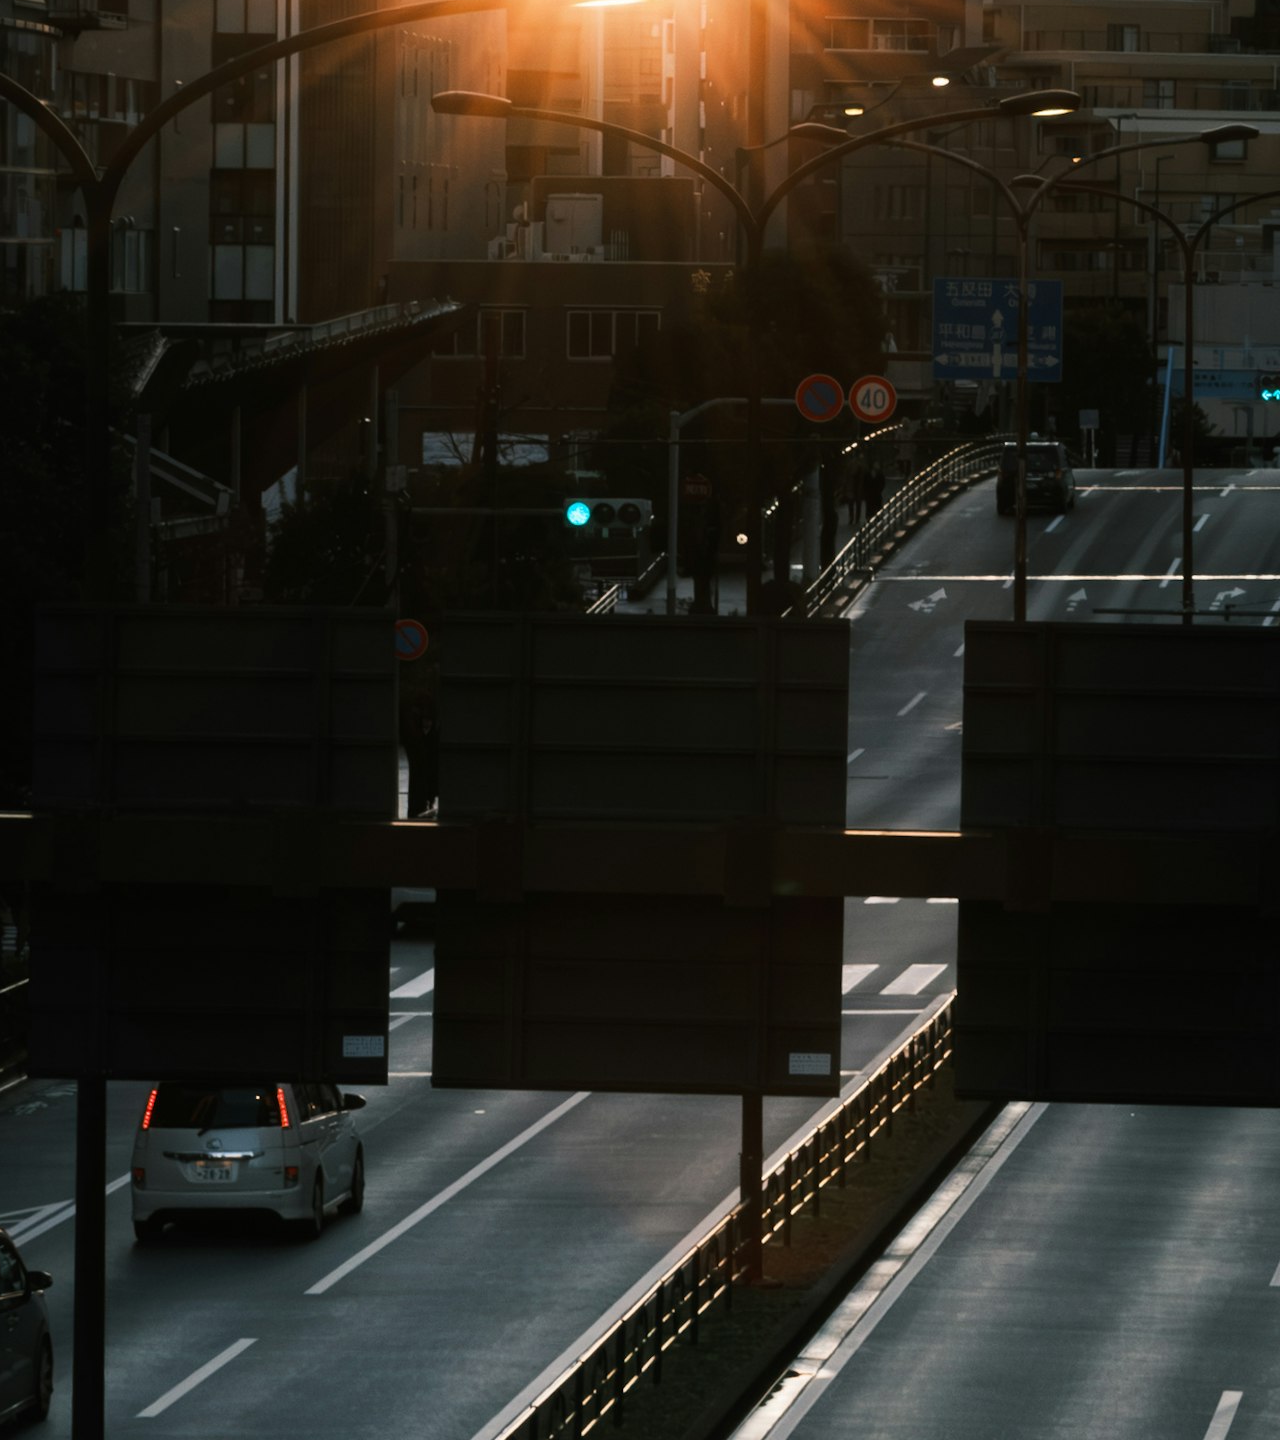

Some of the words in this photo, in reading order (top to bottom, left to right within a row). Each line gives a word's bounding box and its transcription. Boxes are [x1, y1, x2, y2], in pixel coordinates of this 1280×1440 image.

[946, 282, 992, 297] 五反田
[861, 389, 886, 409] 40
